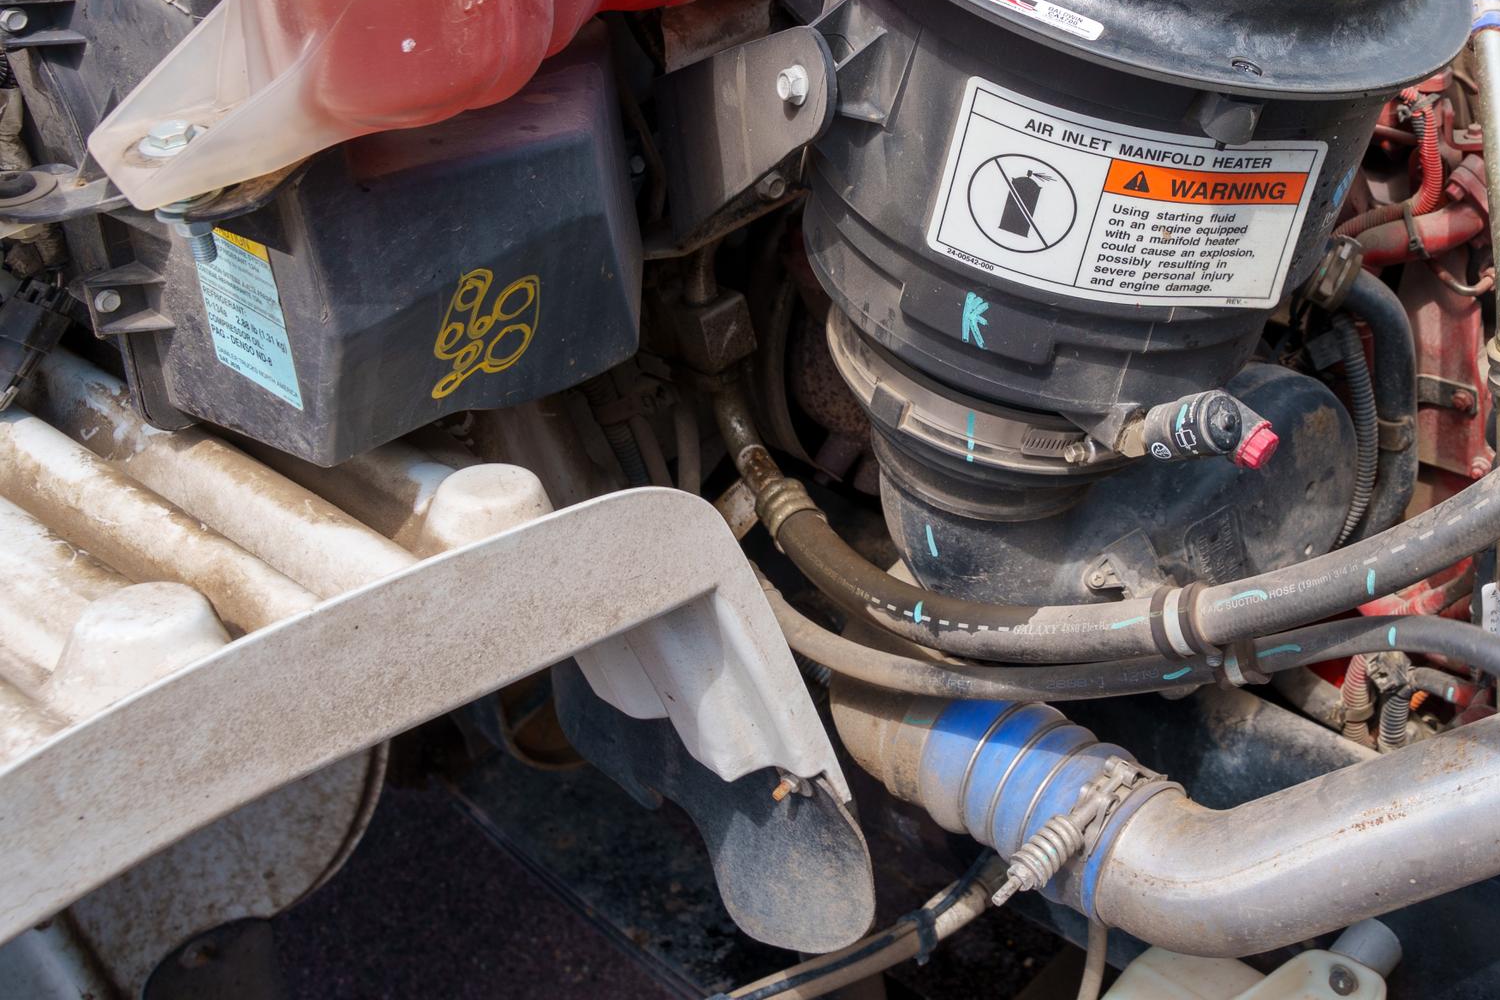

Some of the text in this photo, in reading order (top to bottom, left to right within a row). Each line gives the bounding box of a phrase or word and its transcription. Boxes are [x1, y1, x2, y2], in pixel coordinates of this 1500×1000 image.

[1025, 118, 1273, 169] AIR INLET MANIFOLD HEATER
[1171, 179, 1287, 200] WARNING
[1112, 203, 1236, 224] Using starting fluid
[1105, 229, 1131, 241] with
[1150, 235, 1200, 246] manifold
[1205, 237, 1240, 246] heater
[1109, 218, 1248, 236] on an engine equipped
[946, 247, 994, 271] 24-00542-000
[1101, 241, 1256, 259] could cause an explosion,
[1097, 253, 1227, 271] possibly resulting in
[1094, 265, 1234, 282] severe personal injury
[1090, 276, 1213, 293] and engine damage.
[208, 312, 251, 343] COMPRESSOR
[231, 335, 255, 356] DENSO
[1268, 586, 1297, 599] HOSE
[1298, 574, 1332, 593] (19mm)
